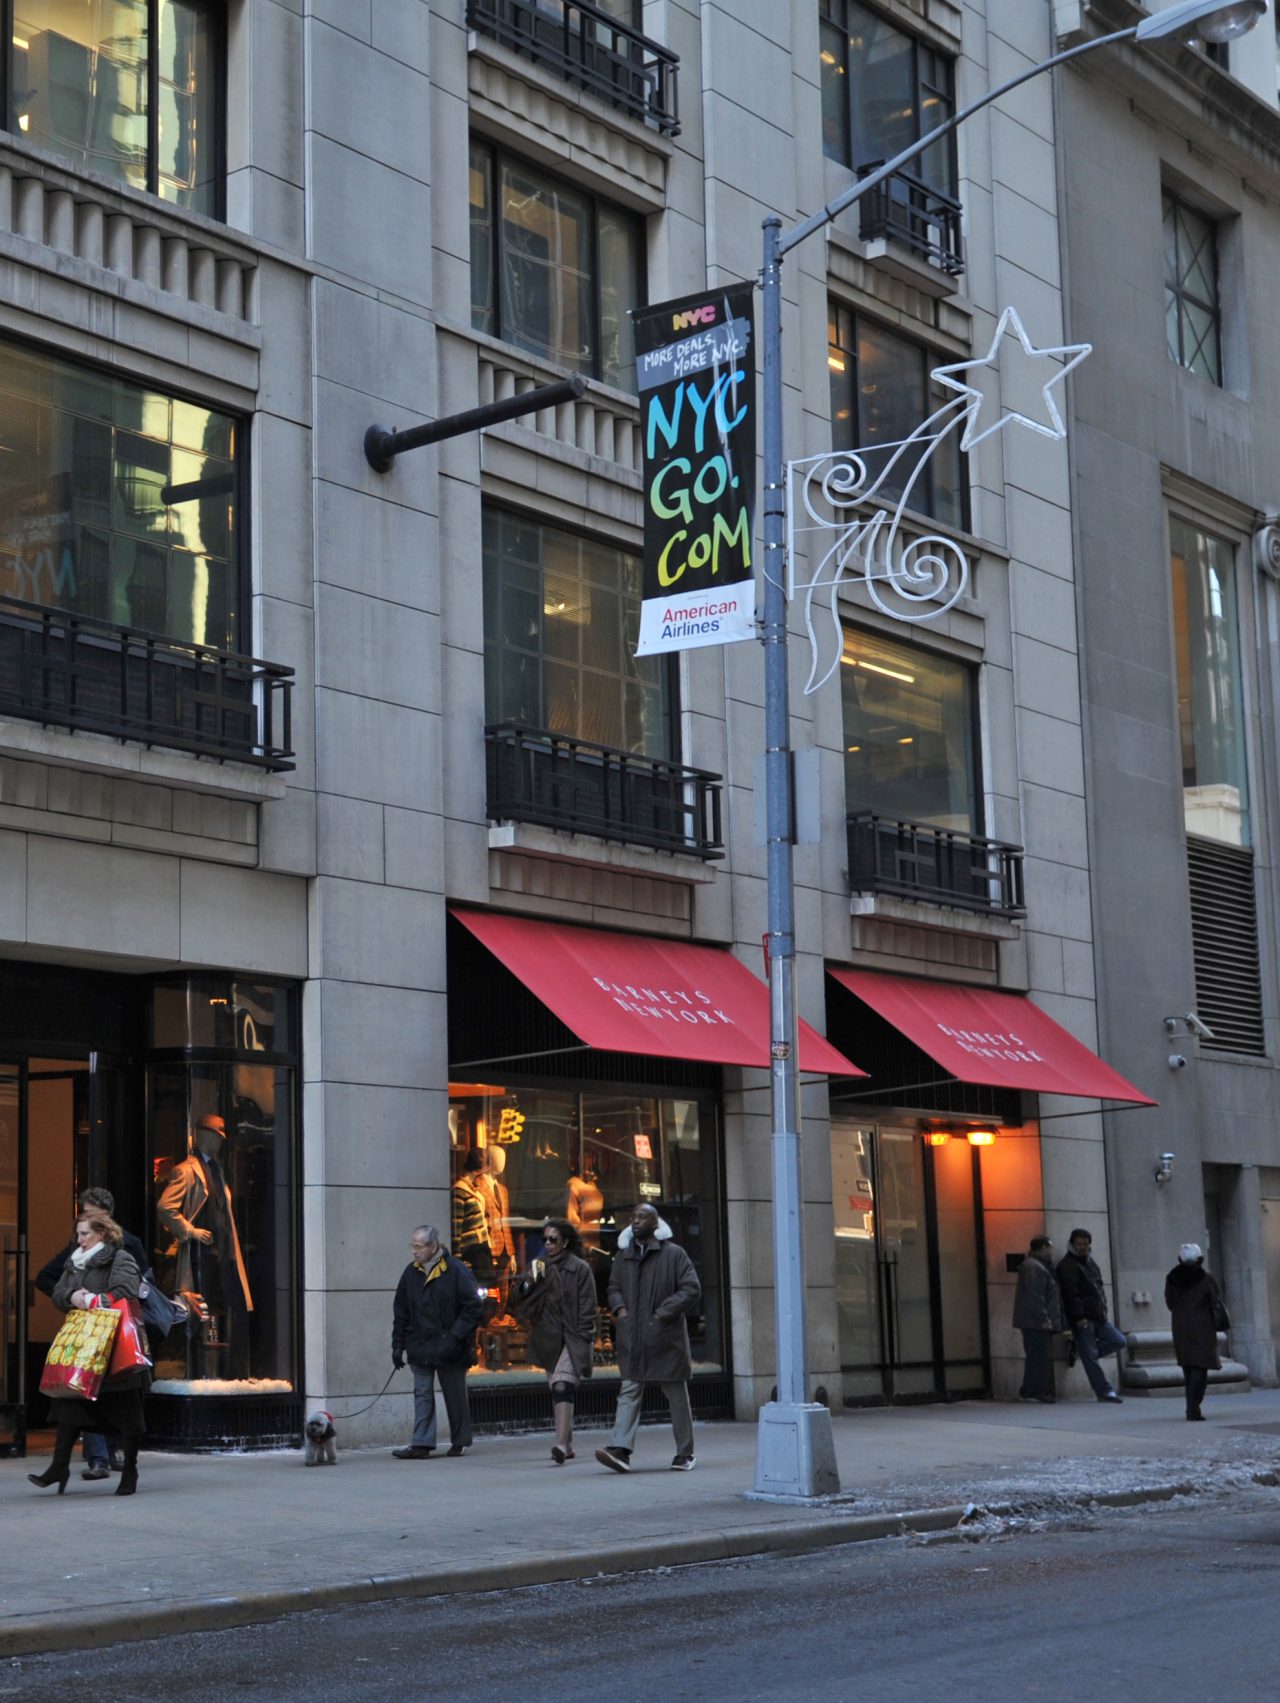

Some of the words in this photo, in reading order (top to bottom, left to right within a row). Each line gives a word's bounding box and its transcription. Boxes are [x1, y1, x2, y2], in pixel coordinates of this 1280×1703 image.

[672, 305, 716, 331] NYC
[644, 345, 675, 372] MORE
[677, 333, 716, 358] DEALS.
[674, 351, 707, 377] MORE
[712, 338, 744, 362] NYC.
[646, 370, 748, 460] NYC
[650, 455, 740, 524] GO.
[662, 600, 737, 624] American
[661, 619, 720, 640] Airlines
[593, 977, 712, 1006] BARNEYS
